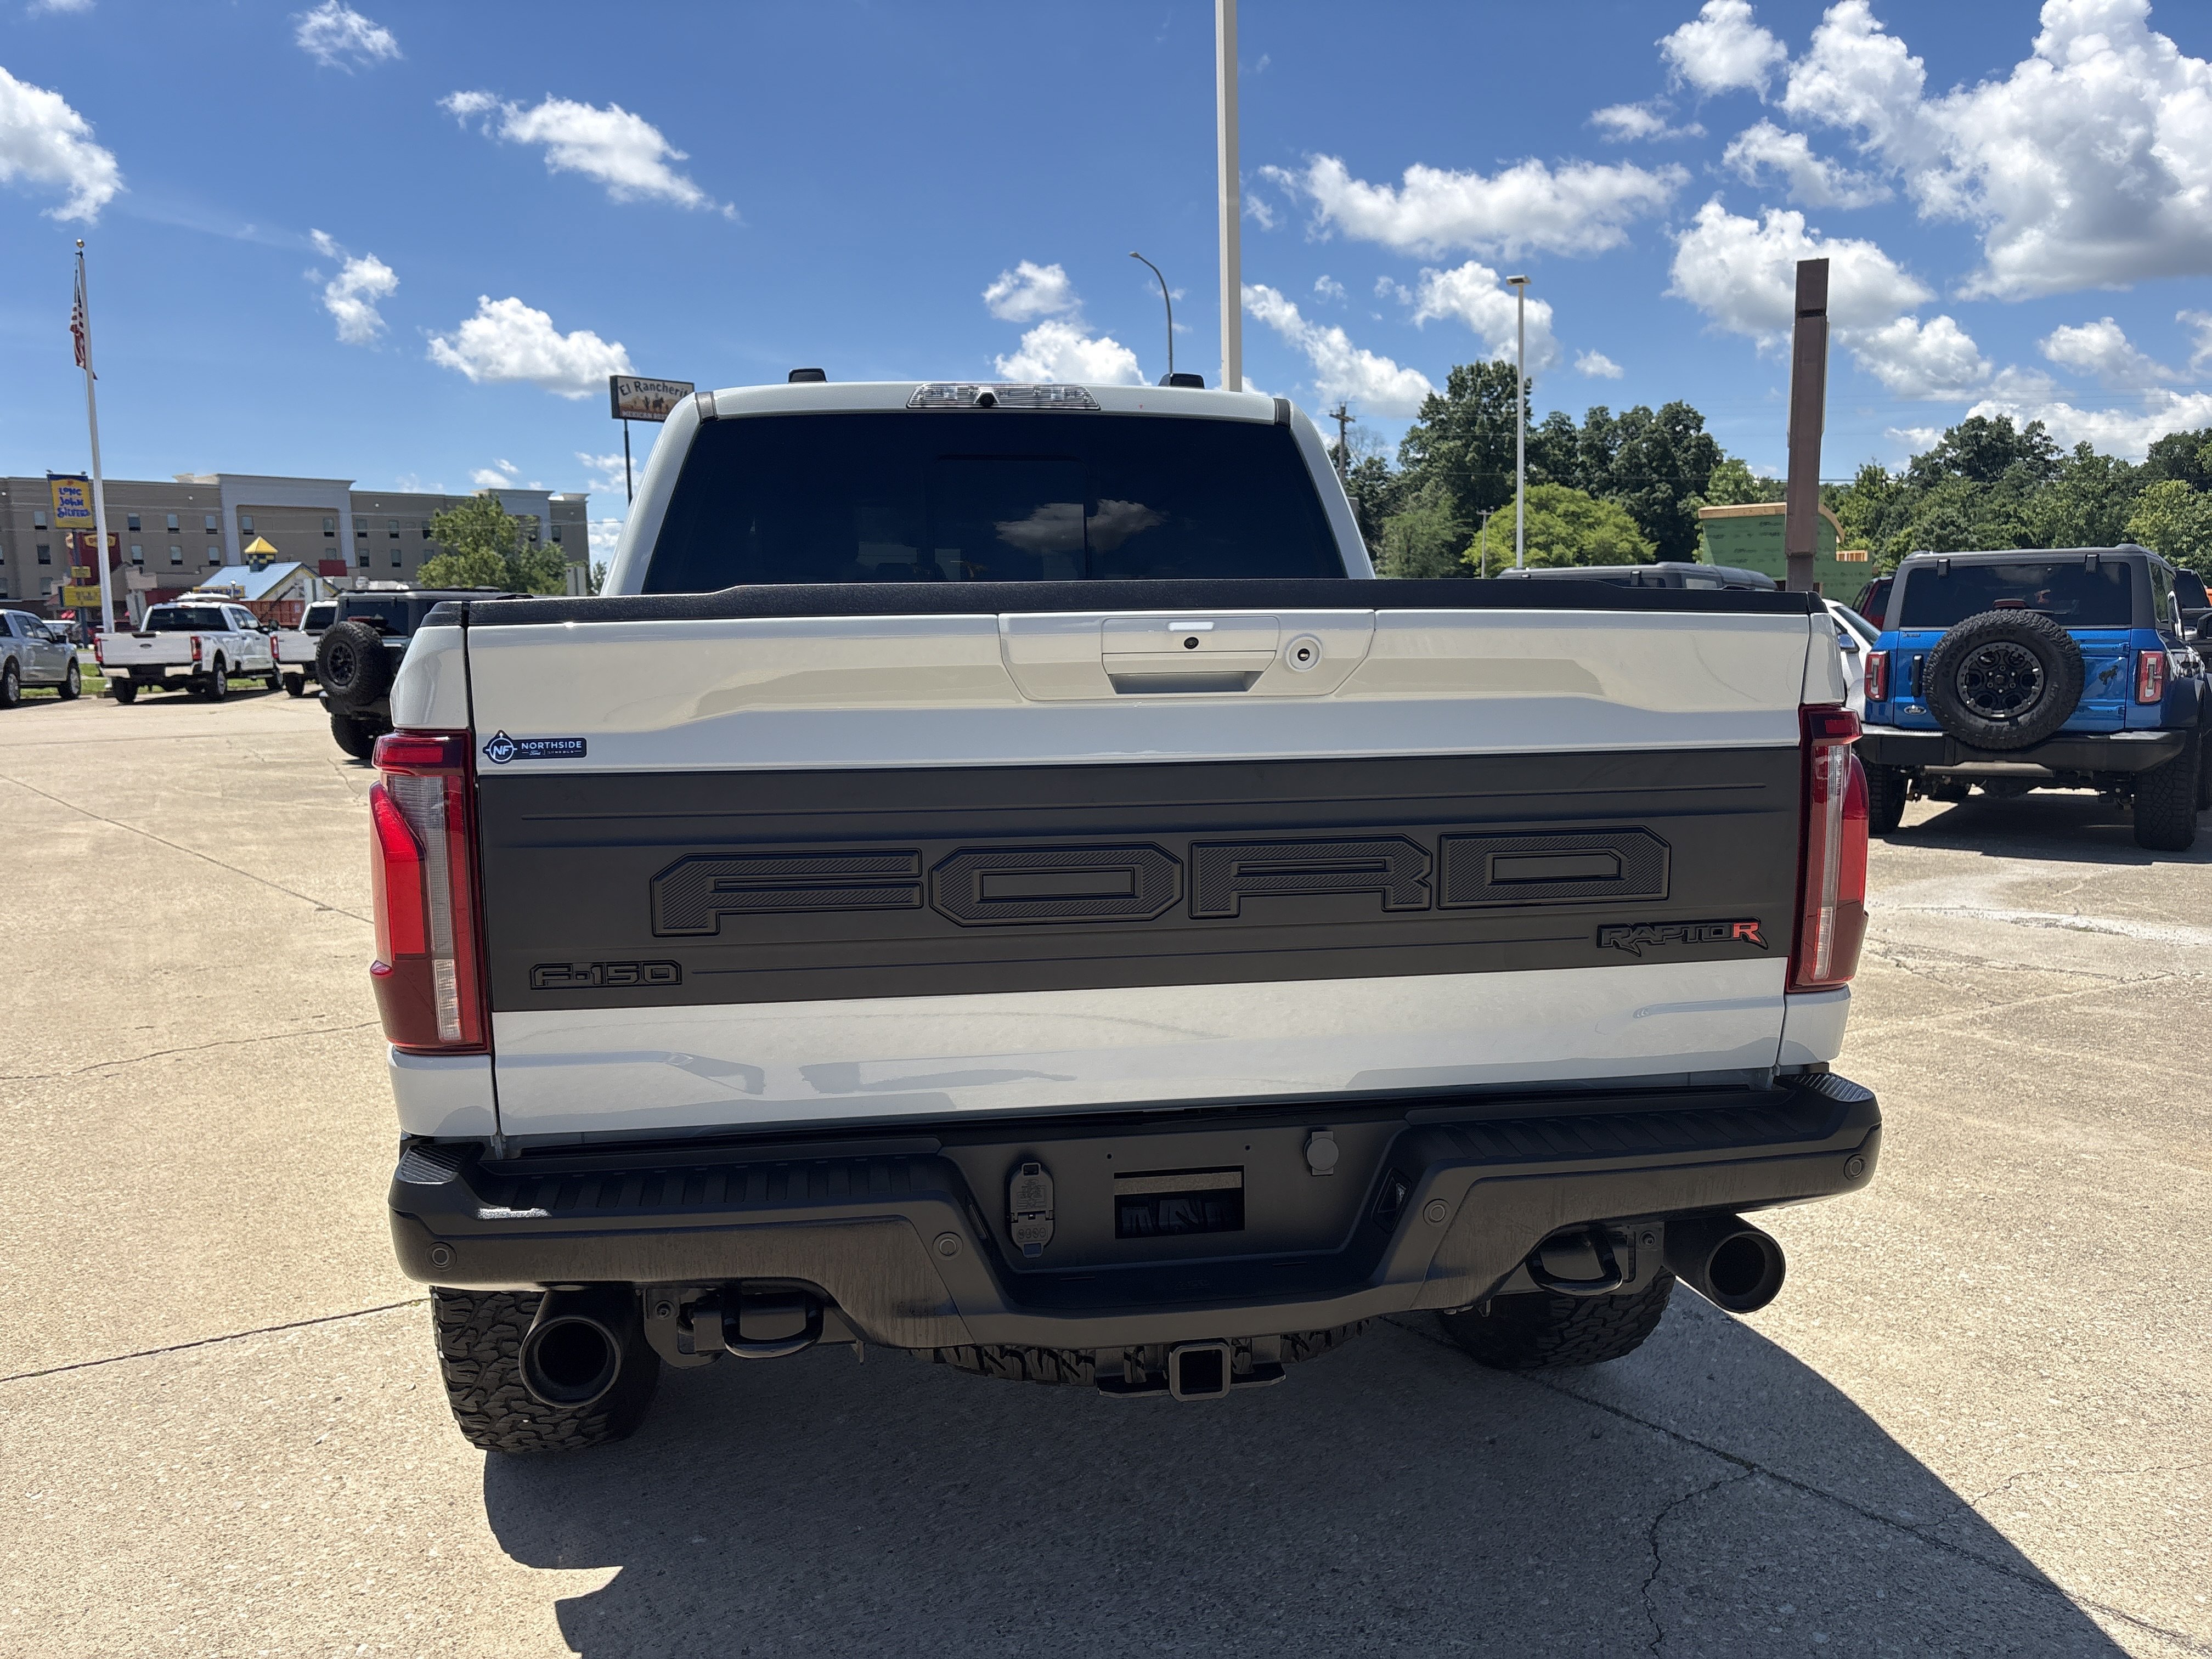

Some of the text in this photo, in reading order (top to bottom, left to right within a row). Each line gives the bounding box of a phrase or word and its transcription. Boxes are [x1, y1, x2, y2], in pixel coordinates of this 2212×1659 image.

[619, 381, 689, 398] El Rancherit
[493, 745, 514, 759] NF
[521, 741, 582, 750] NORTHSIDE
[650, 825, 1672, 938] FORD
[530, 960, 682, 990] F-150
